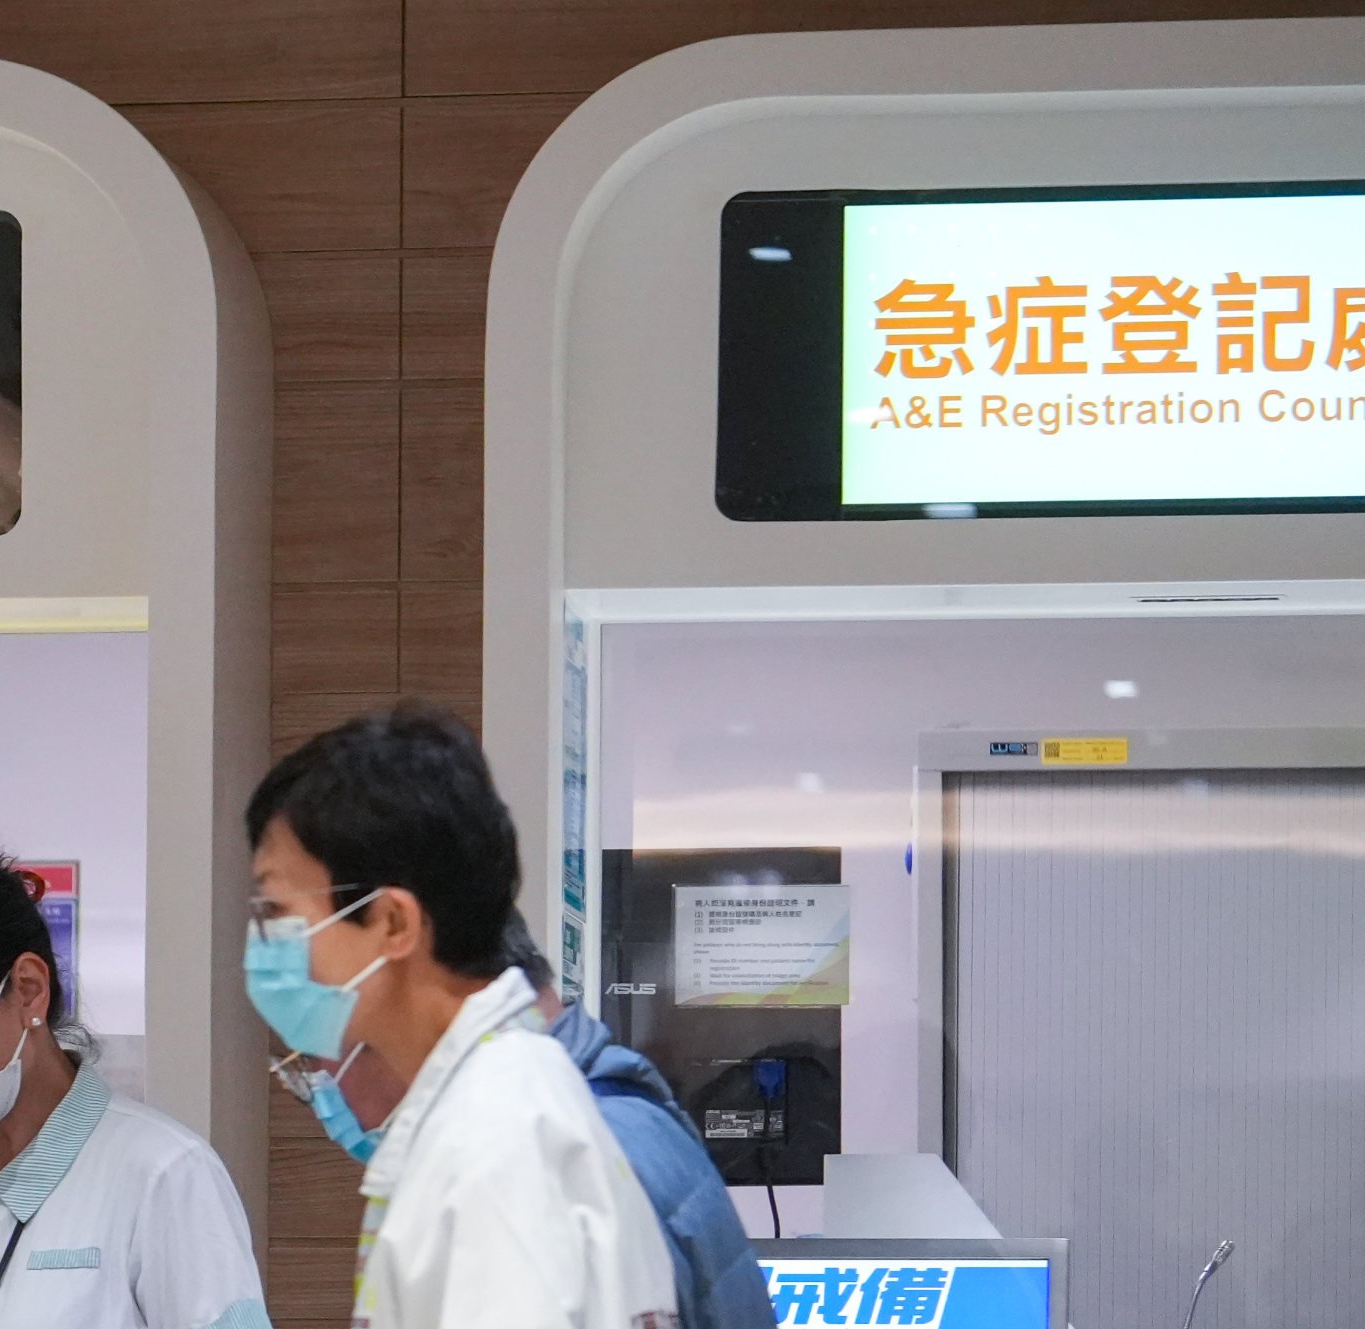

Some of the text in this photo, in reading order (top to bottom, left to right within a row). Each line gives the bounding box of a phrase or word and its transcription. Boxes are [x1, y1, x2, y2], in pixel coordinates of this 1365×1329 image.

[872, 395, 963, 429] A&E
[981, 390, 1241, 436] Registration
[605, 982, 657, 995] ASUS
